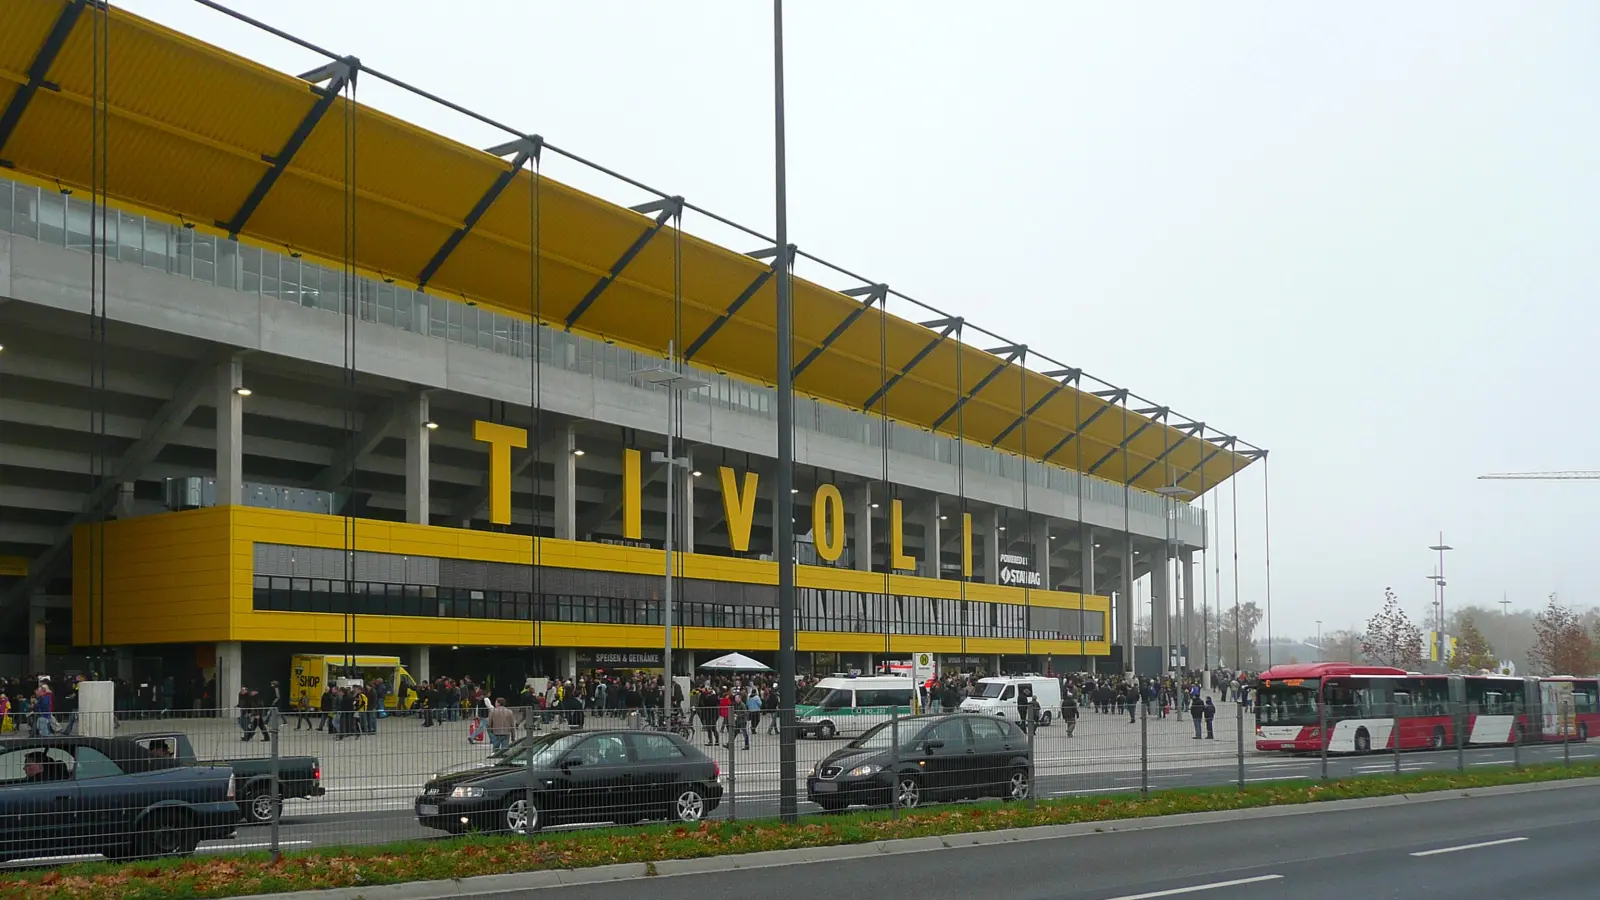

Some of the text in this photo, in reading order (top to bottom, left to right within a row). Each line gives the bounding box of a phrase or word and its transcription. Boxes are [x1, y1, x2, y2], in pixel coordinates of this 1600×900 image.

[473, 420, 973, 577] TIVOLI
[596, 653, 621, 662] SPEISEN
[622, 654, 628, 662] &
[629, 652, 659, 662] GETRÄNKE
[300, 675, 320, 687] SHOP
